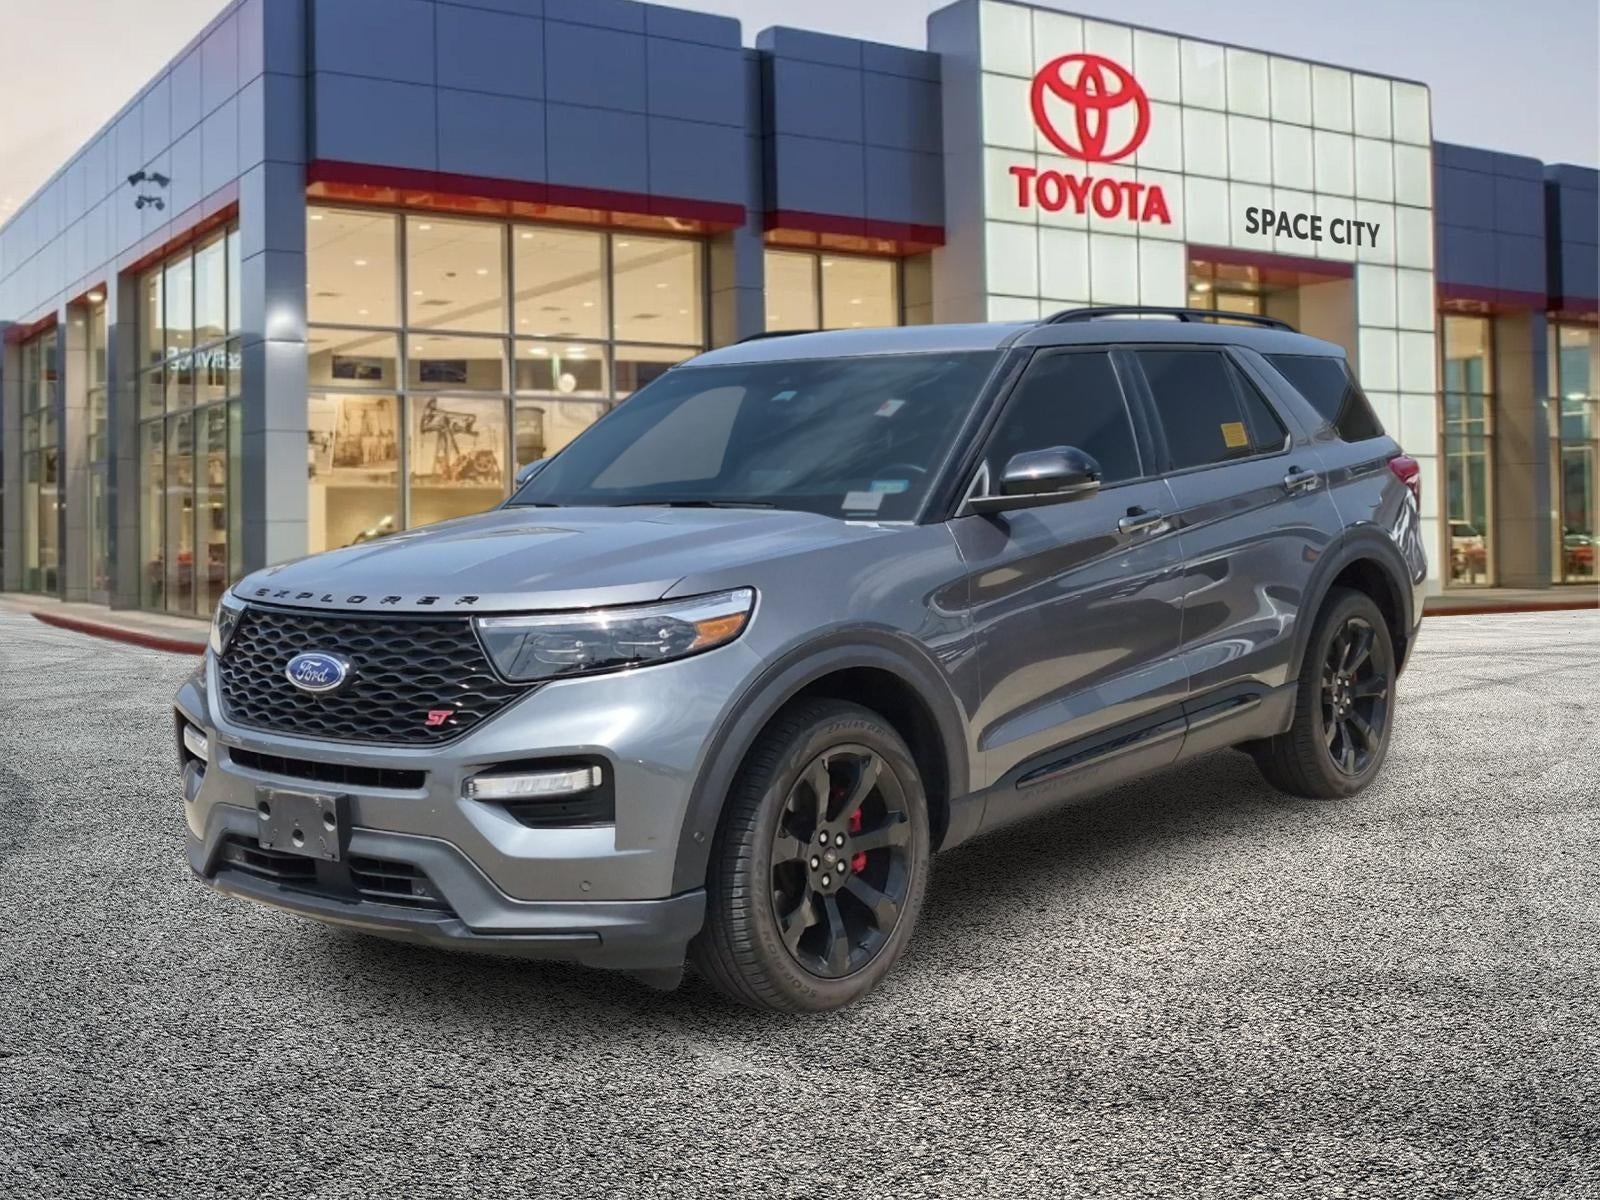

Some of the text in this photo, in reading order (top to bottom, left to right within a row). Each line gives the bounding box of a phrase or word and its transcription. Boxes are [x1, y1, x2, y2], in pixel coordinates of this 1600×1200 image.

[1009, 166, 1171, 224] TOYOTA
[1245, 207, 1380, 248] SPACE CITY
[255, 588, 479, 606] EXPLORER
[296, 660, 330, 683] Ford
[425, 710, 454, 726] ST
